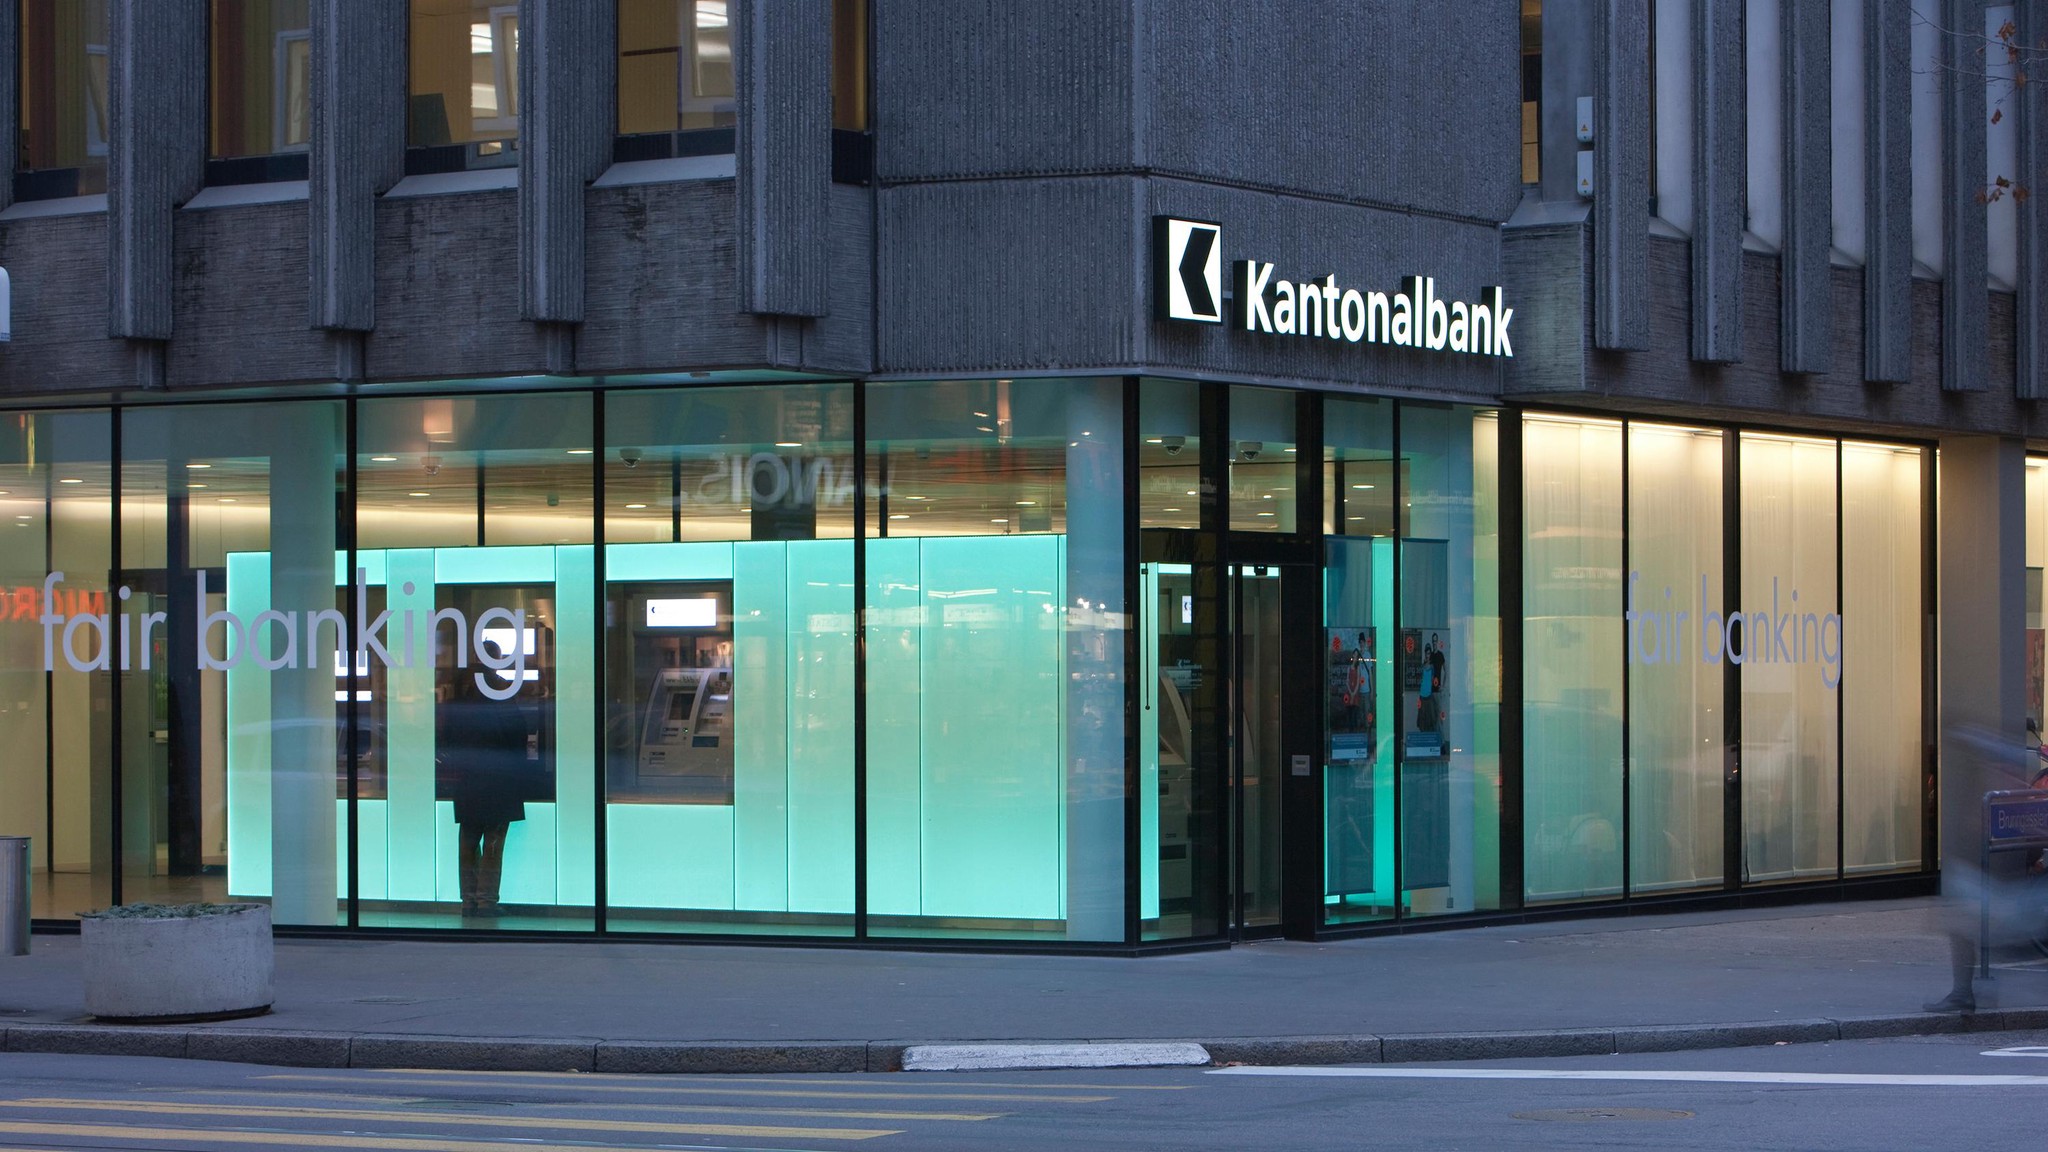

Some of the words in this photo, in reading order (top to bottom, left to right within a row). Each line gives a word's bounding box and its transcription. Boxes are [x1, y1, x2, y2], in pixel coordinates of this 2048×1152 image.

[1246, 259, 1514, 358] Kantonalbank
[40, 571, 168, 673] fair
[197, 567, 525, 700] banking
[1626, 570, 1689, 665] fair
[1702, 573, 1842, 690] banking
